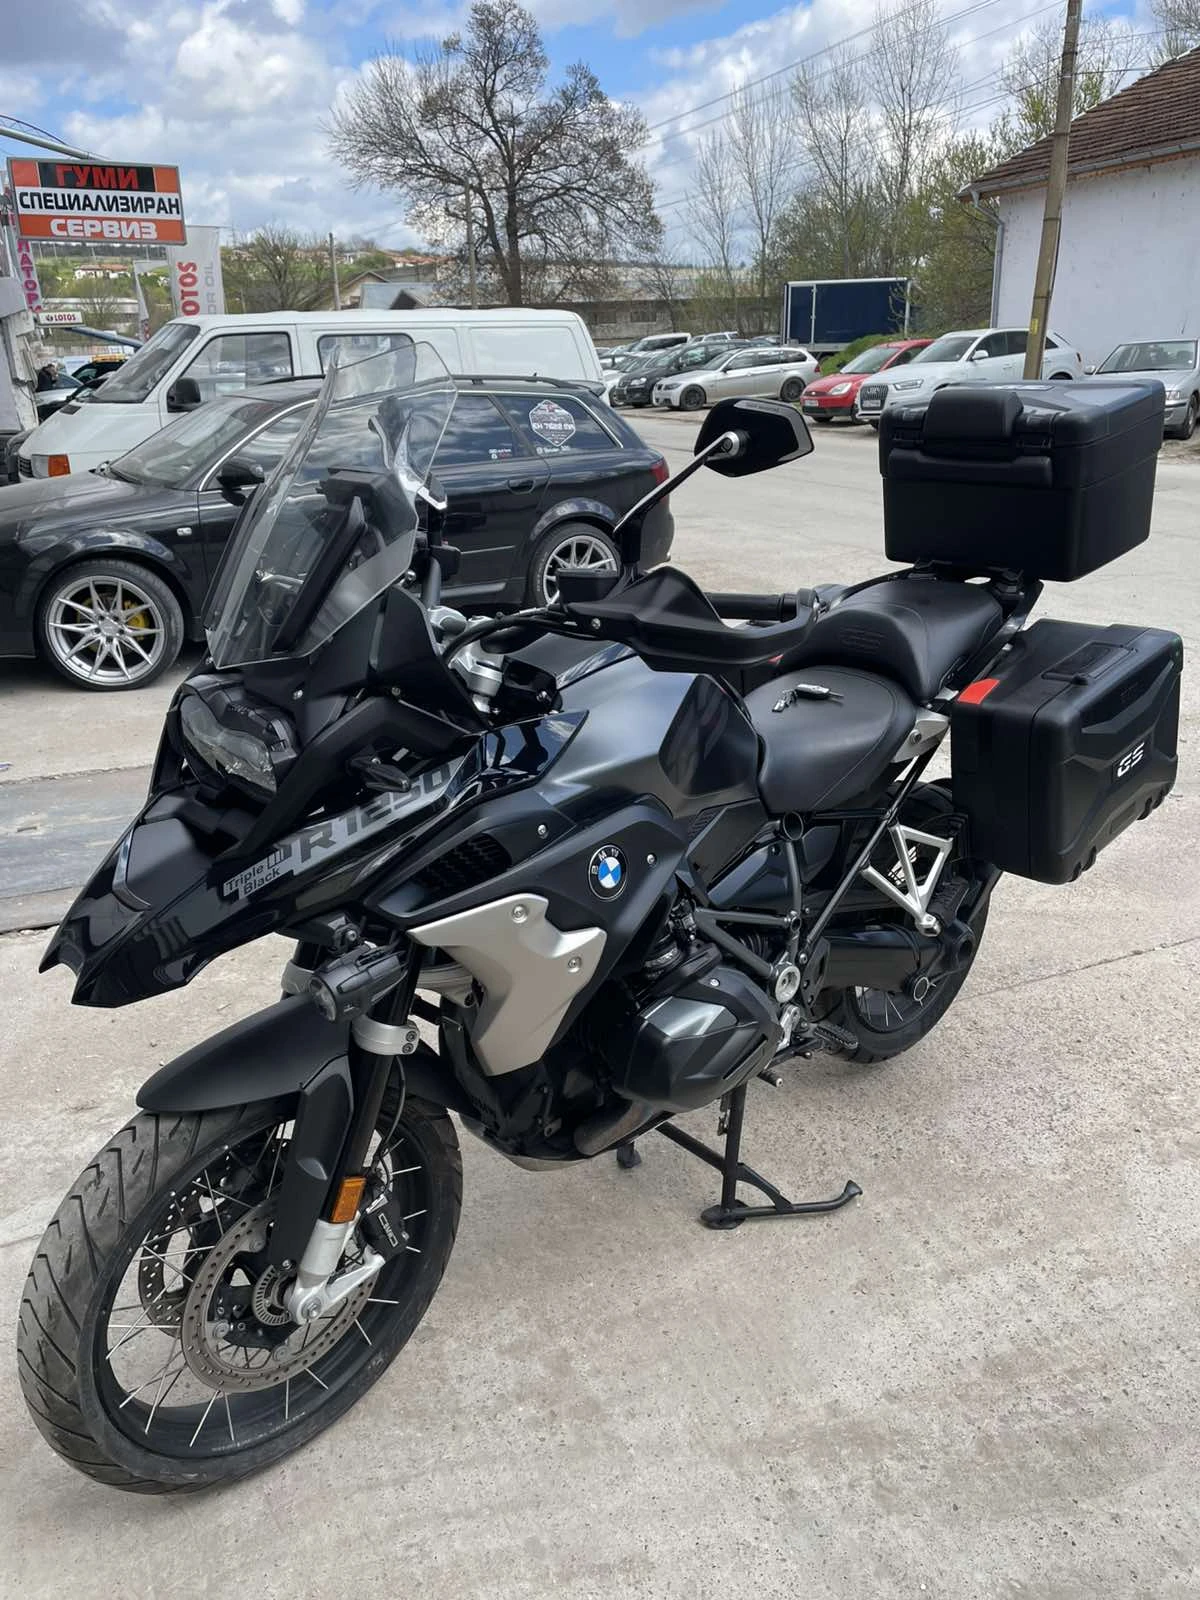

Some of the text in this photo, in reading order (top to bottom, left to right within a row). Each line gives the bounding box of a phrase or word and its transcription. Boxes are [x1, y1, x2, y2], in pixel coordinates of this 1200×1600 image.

[55, 164, 140, 190] ГУМИ
[19, 191, 181, 215] СПЕЦИАЛИЗИРАН
[50, 218, 158, 240] СЕРВИЗ
[176, 261, 200, 317] OTOS
[54, 312, 77, 321] LOTOS
[1117, 742, 1145, 778] GS
[225, 864, 264, 891] Triple
[243, 867, 281, 895] Black
